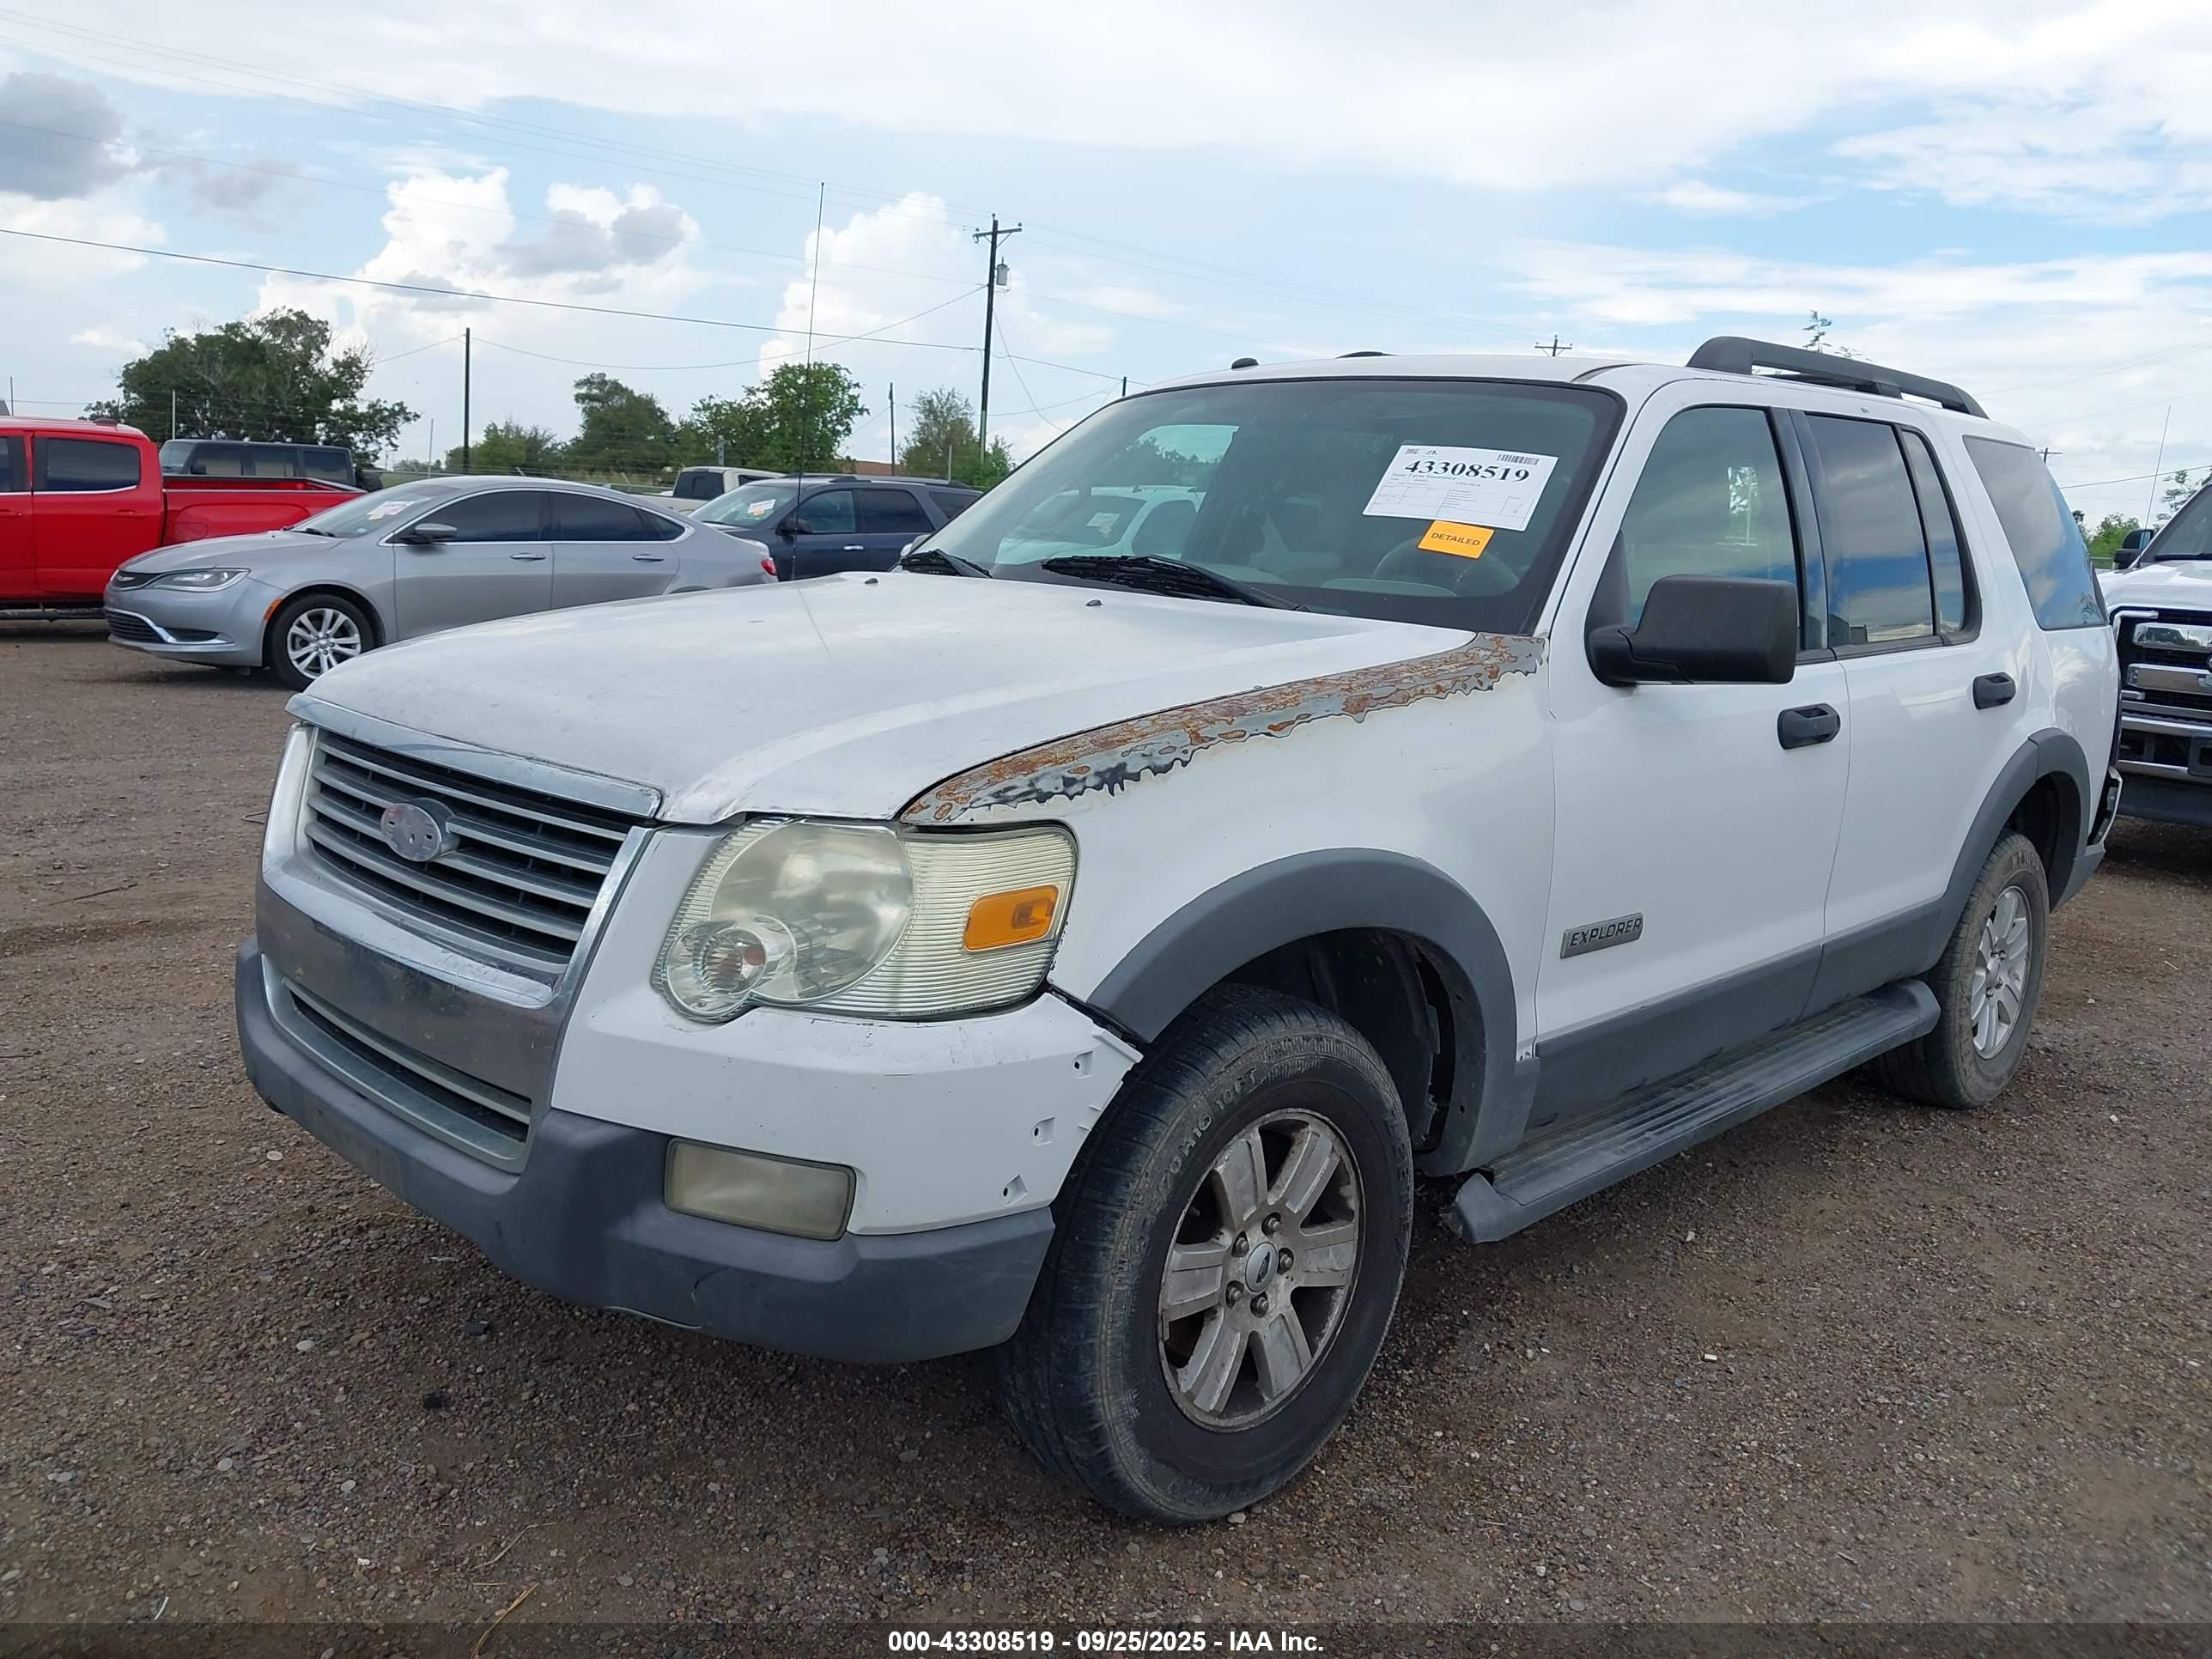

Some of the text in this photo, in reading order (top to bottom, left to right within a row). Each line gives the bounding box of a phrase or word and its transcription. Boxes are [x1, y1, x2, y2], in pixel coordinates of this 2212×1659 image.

[1405, 459, 1529, 483] 43308519
[1431, 532, 1480, 547] DETAILED
[1570, 918, 1642, 946] EXPLORER
